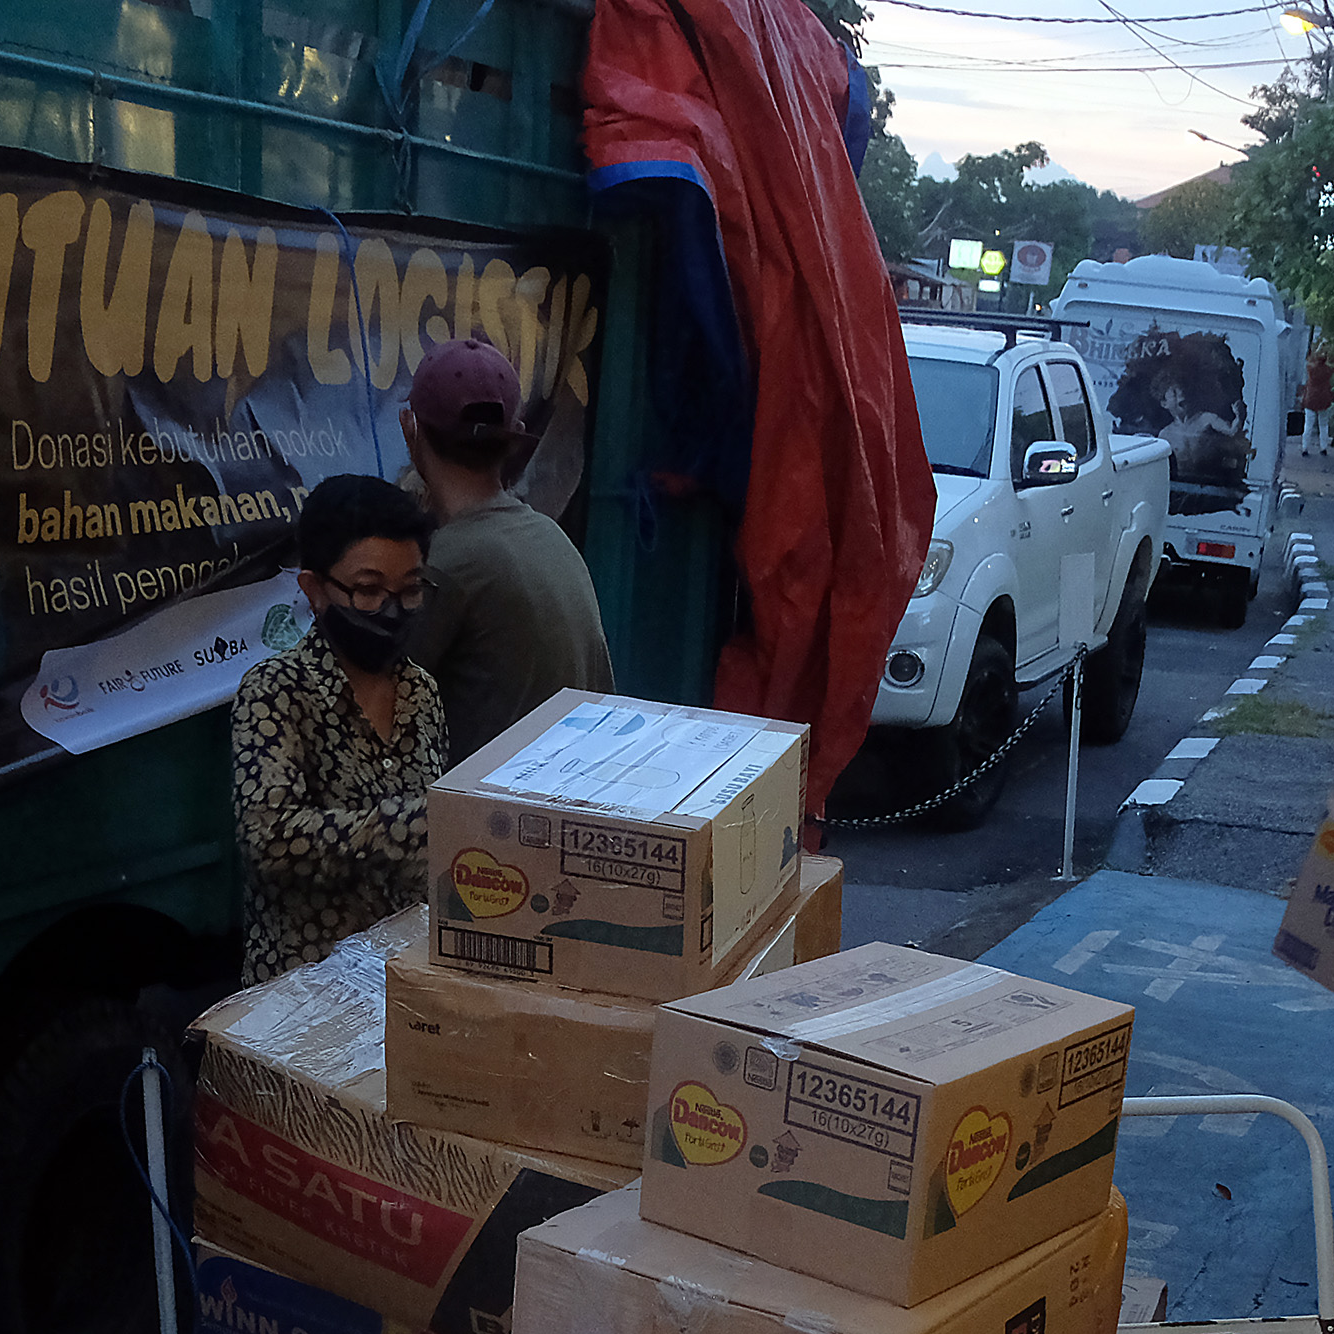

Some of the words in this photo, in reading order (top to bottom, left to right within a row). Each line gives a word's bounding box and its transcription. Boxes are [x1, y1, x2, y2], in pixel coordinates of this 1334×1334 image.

[306, 231, 598, 407] LOGISTIK
[11, 418, 114, 472] Donasi
[119, 412, 273, 468] kebutuhan
[277, 424, 347, 466] pokok
[17, 484, 124, 545] bahan
[129, 485, 293, 537] makanan,
[25, 560, 110, 617] hasil
[140, 659, 184, 684] FUTURE
[714, 782, 740, 805] SUSU
[737, 763, 764, 789] BAYI
[570, 829, 678, 865] 12365144
[1068, 1033, 1126, 1075] 12365144
[797, 1070, 912, 1126] 12365144
[811, 1109, 890, 1149] 16(10x27g)
[263, 1144, 423, 1246] SATU
